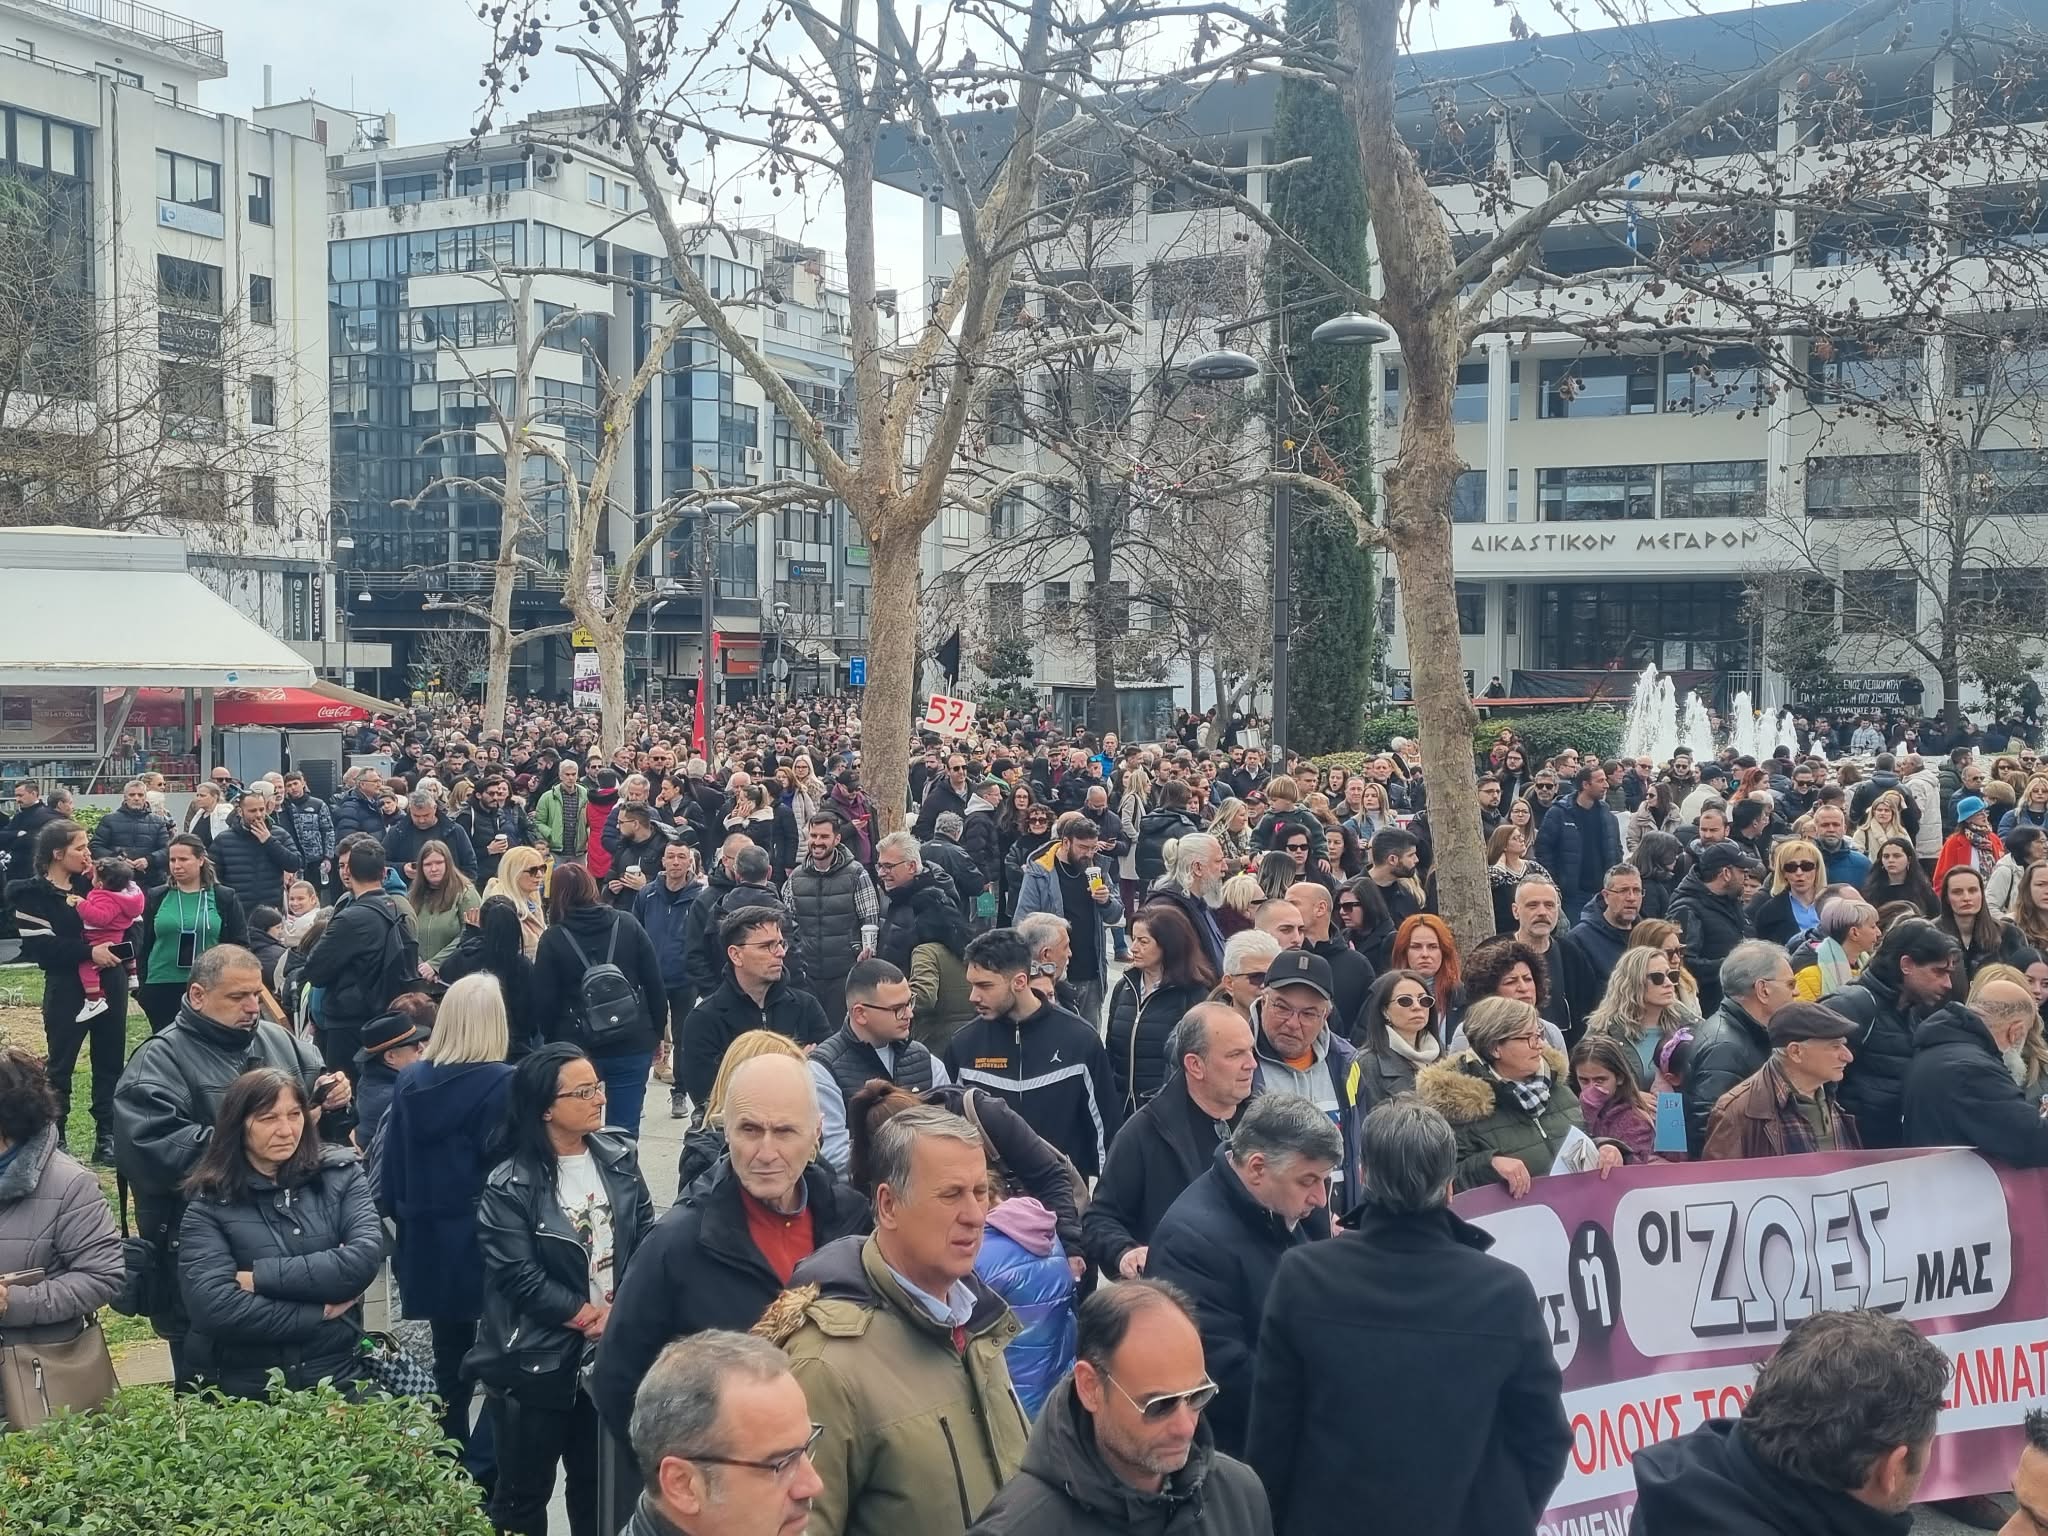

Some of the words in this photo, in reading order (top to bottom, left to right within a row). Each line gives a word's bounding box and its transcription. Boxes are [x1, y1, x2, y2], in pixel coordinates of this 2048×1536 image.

[1471, 534, 1616, 552] ΔΙΚΑΣΤΙΚΟΝ
[1636, 531, 1758, 550] ΜΕΓΑΡΟΝ
[1540, 1293, 1570, 1345] Σ
[1579, 1230, 1611, 1327] ή
[1637, 1210, 1681, 1266] ΟΙ
[1685, 1180, 1908, 1338] ΖΩΕΣ
[1914, 1241, 1994, 1304] ΜΑΣ
